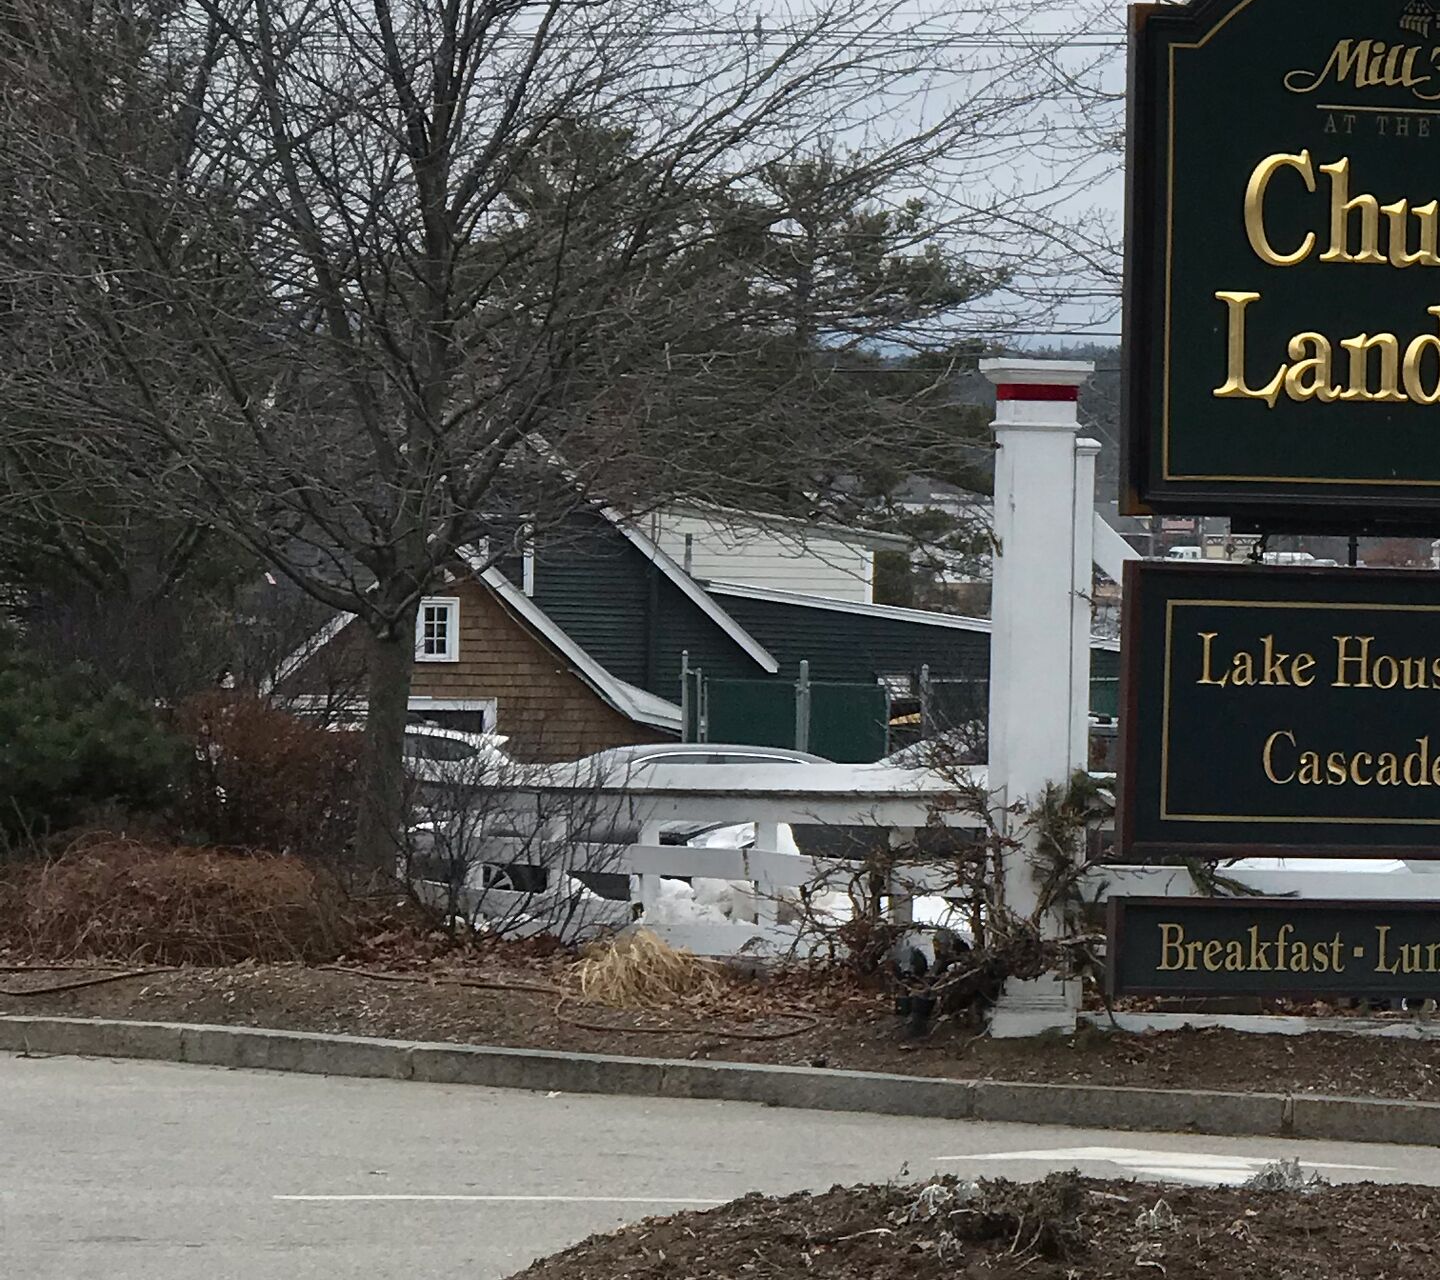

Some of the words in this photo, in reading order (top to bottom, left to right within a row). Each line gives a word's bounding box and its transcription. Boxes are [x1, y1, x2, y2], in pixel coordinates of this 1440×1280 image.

[1283, 38, 1430, 93] Mill
[1323, 113, 1358, 134] AT
[1376, 115, 1430, 137] THE
[1196, 631, 1316, 688] Lake
[1156, 922, 1346, 975] Breakfast
